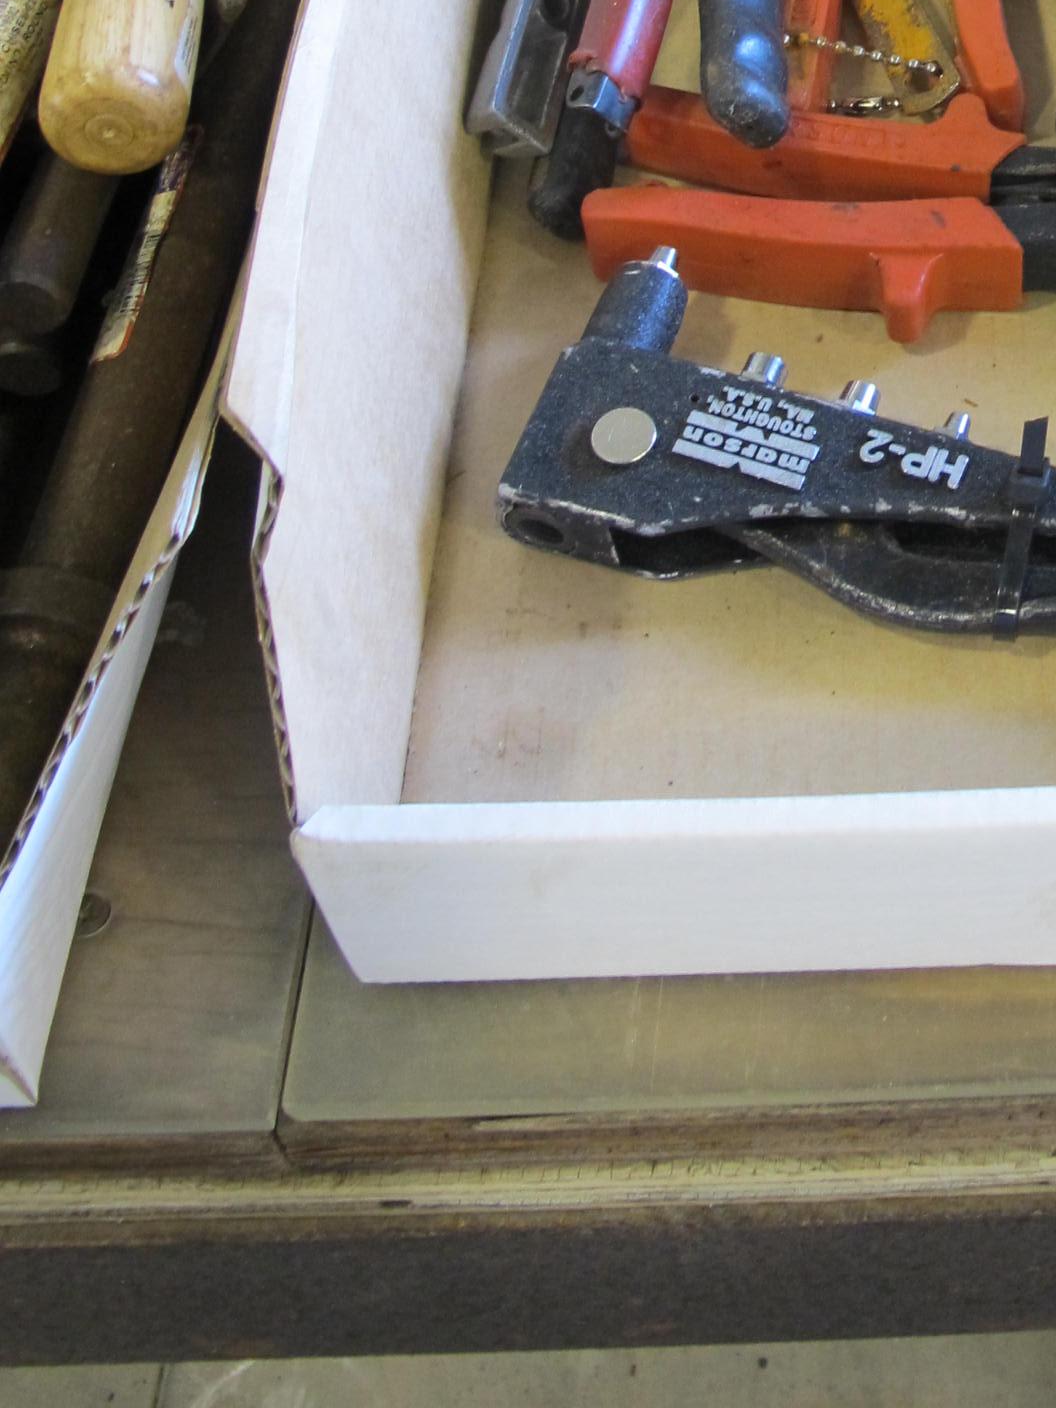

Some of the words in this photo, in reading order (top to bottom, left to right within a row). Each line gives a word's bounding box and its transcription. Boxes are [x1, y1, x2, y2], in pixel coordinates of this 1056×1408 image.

[707, 394, 817, 441] STOUGHTON,
[683, 425, 811, 474] marson
[859, 428, 970, 491] HP-2
